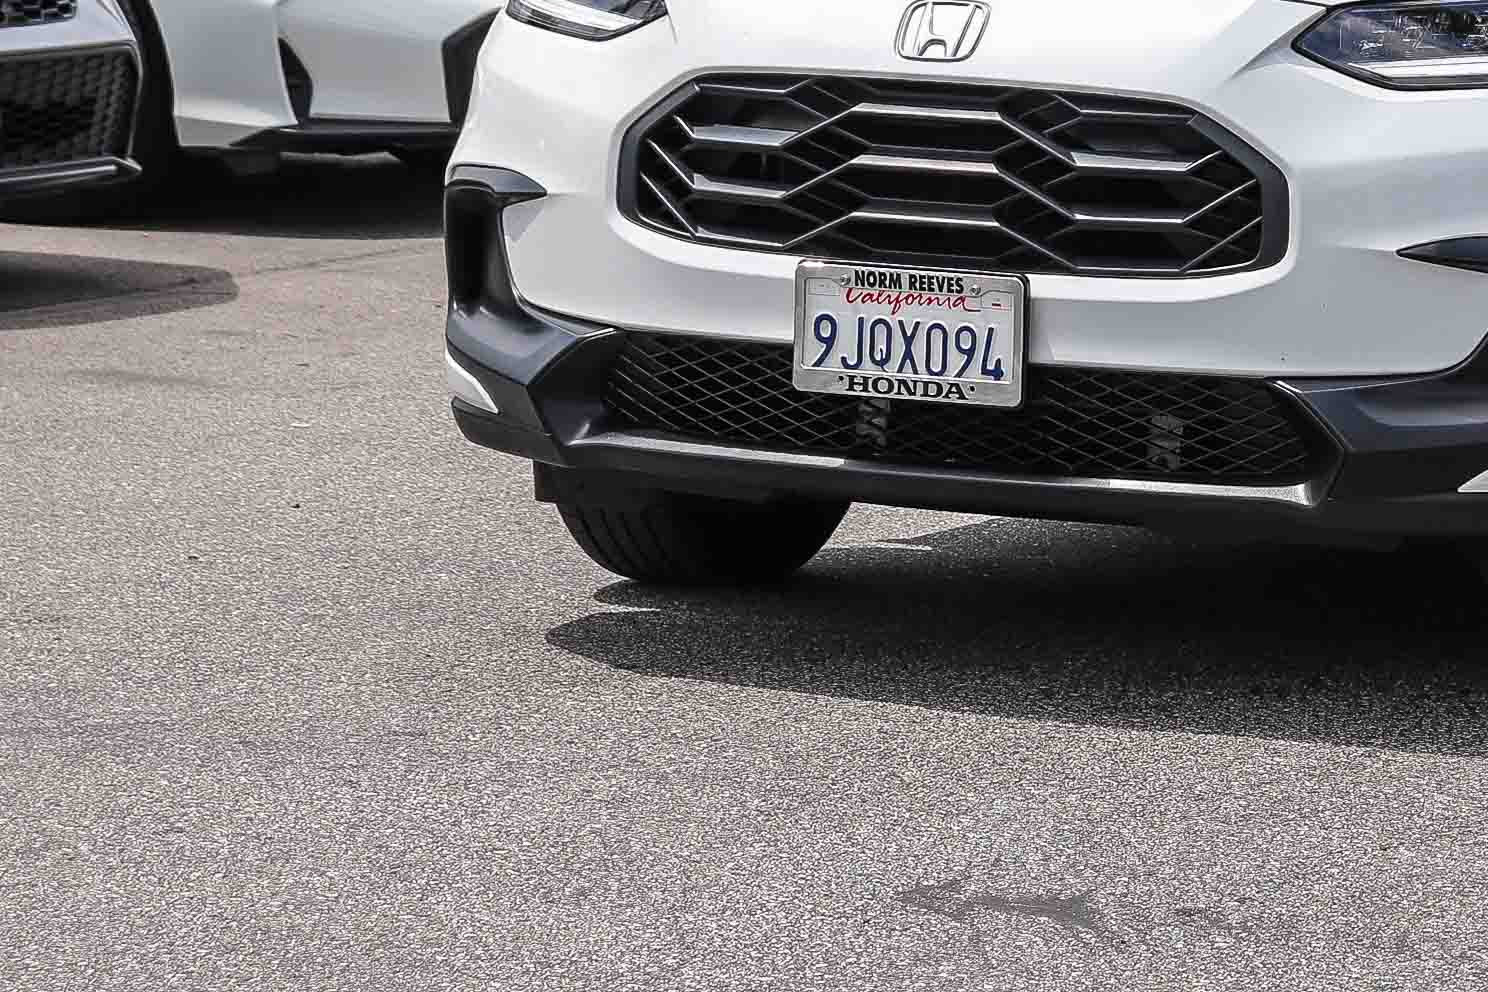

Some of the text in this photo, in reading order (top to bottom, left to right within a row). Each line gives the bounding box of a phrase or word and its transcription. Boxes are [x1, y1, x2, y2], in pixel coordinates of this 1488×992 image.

[854, 269, 964, 294] NORM REEVES
[812, 313, 1004, 381] 9JQX094
[845, 374, 969, 400] HONDA
